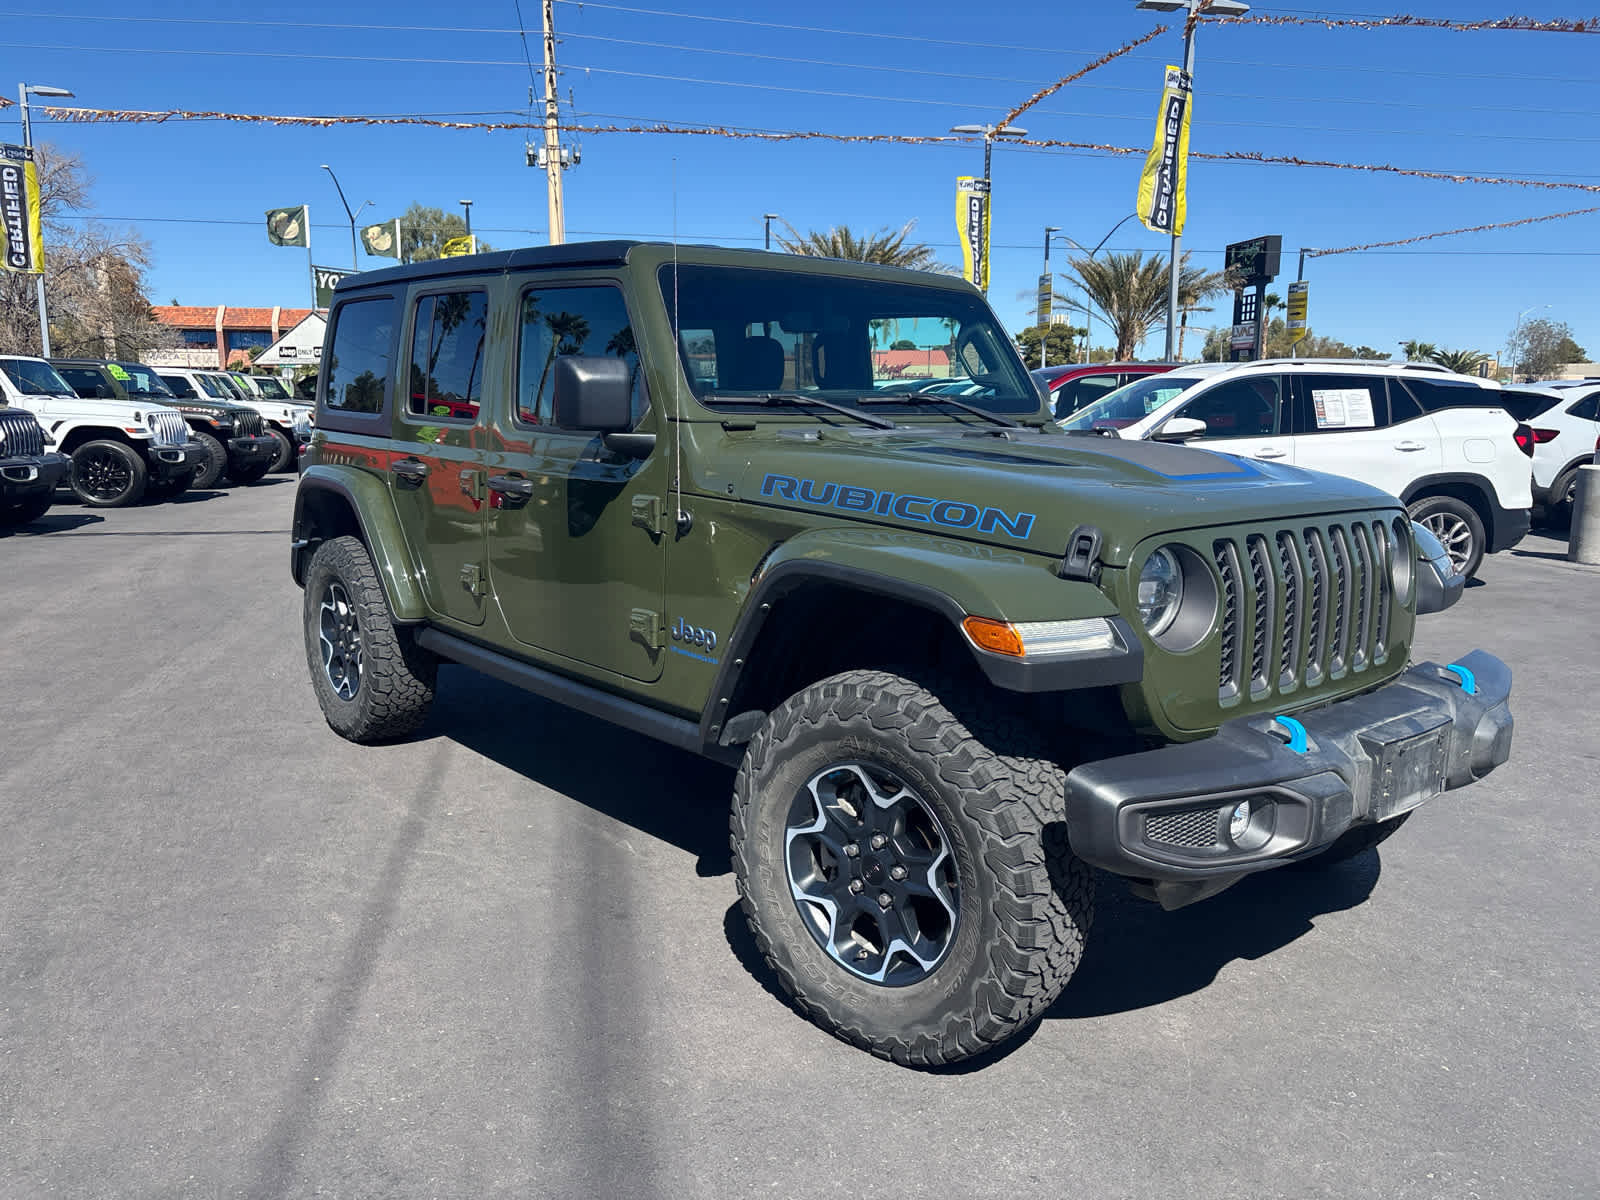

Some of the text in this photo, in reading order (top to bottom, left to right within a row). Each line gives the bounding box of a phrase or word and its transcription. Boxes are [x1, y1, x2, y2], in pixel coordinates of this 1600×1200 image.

[318, 272, 344, 290] YO
[280, 347, 296, 357] Jeep
[760, 473, 1036, 541] RUBICON
[671, 616, 717, 653] Jeep
